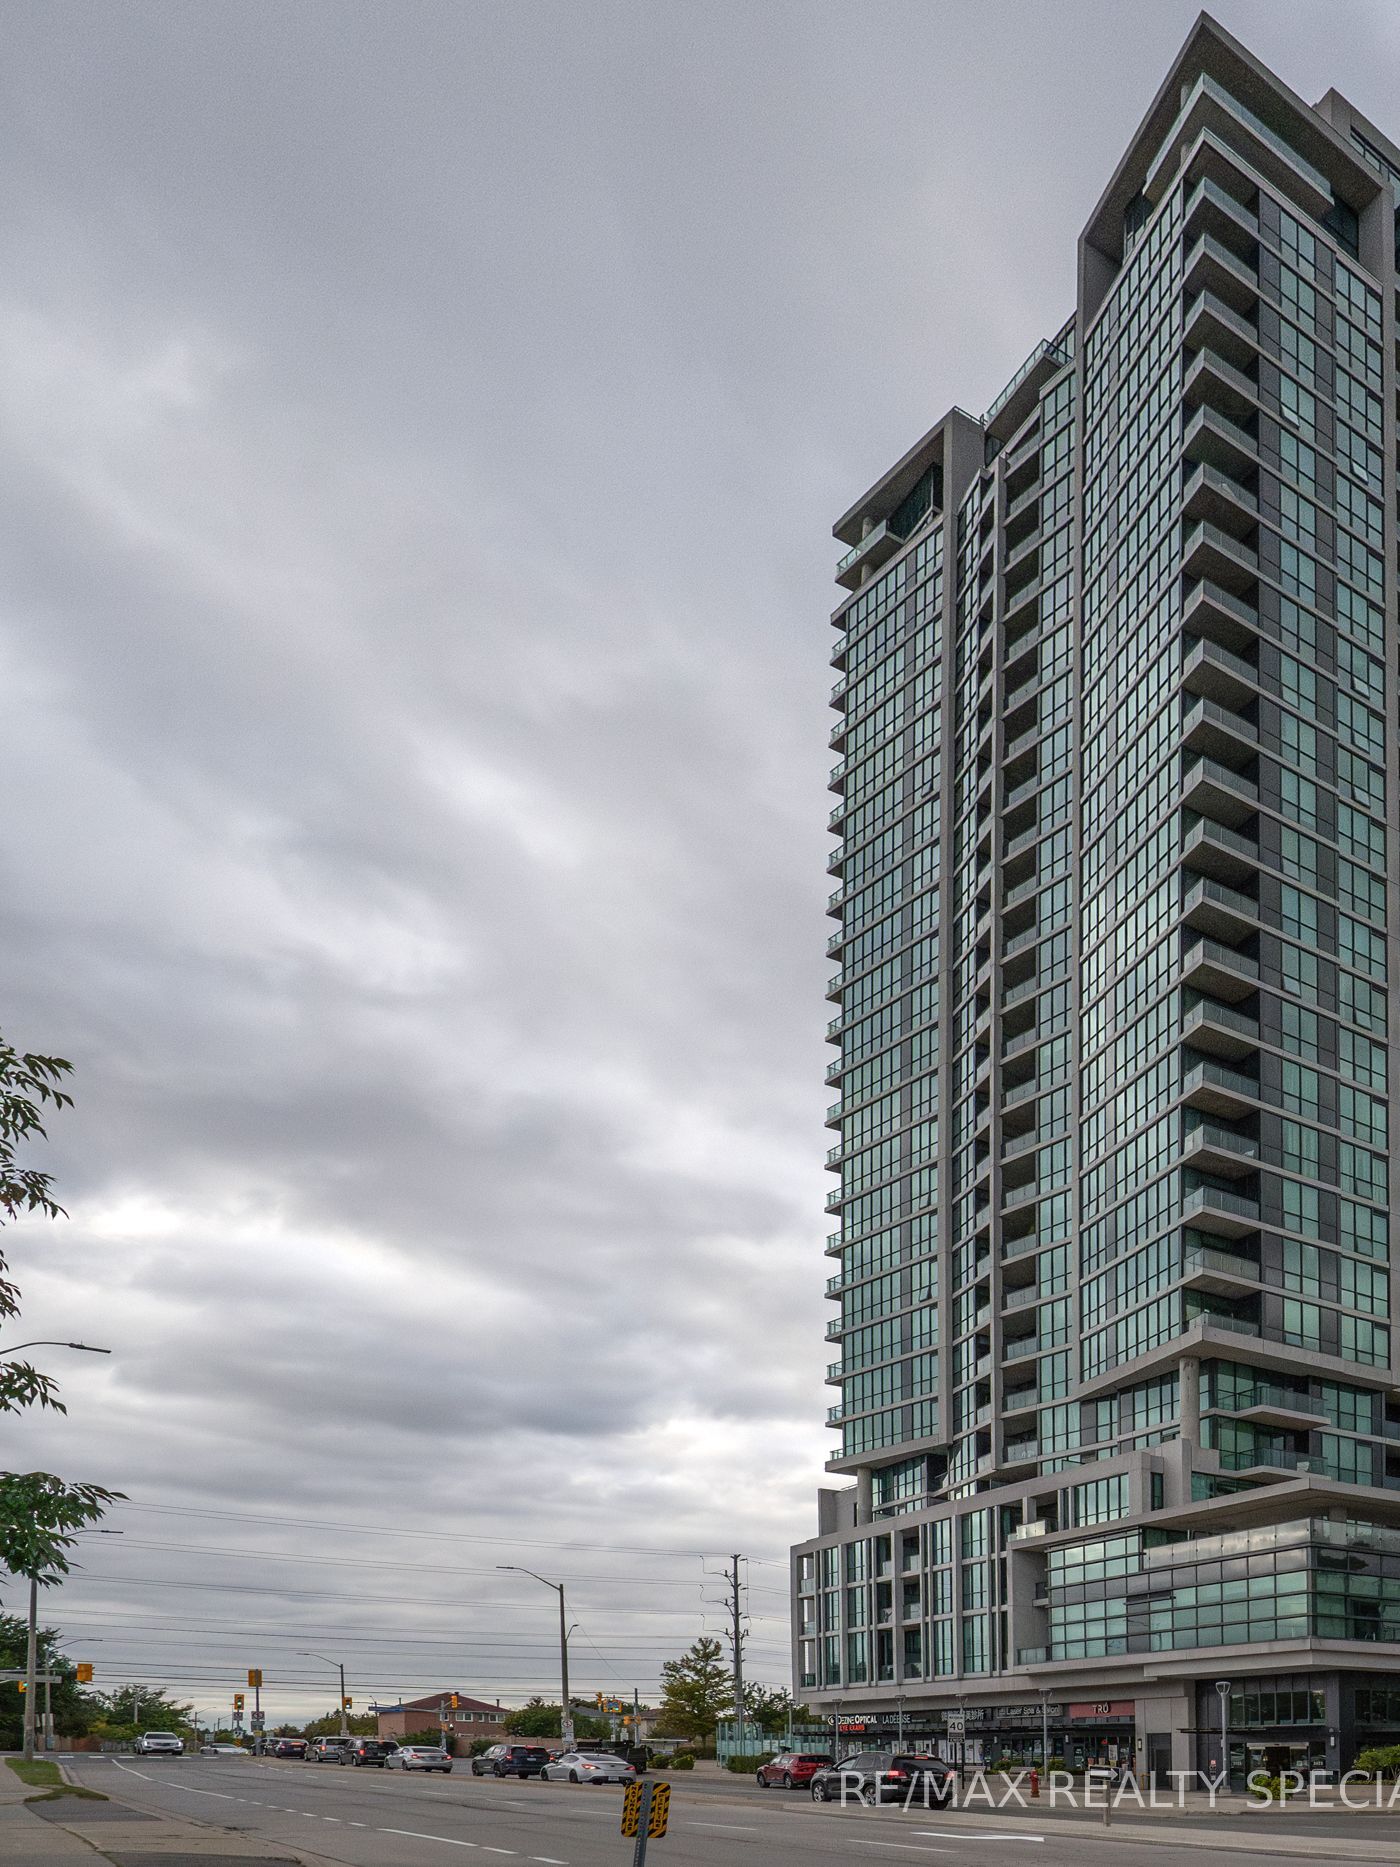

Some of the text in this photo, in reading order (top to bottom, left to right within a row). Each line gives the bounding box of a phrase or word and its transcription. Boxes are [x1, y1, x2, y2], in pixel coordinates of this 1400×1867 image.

[1006, 1707, 1022, 1715] Laser
[1023, 1706, 1035, 1715] Spa
[854, 1714, 878, 1724] OPTICAL
[889, 1713, 911, 1724] DÉESE
[949, 1721, 964, 1731] 40
